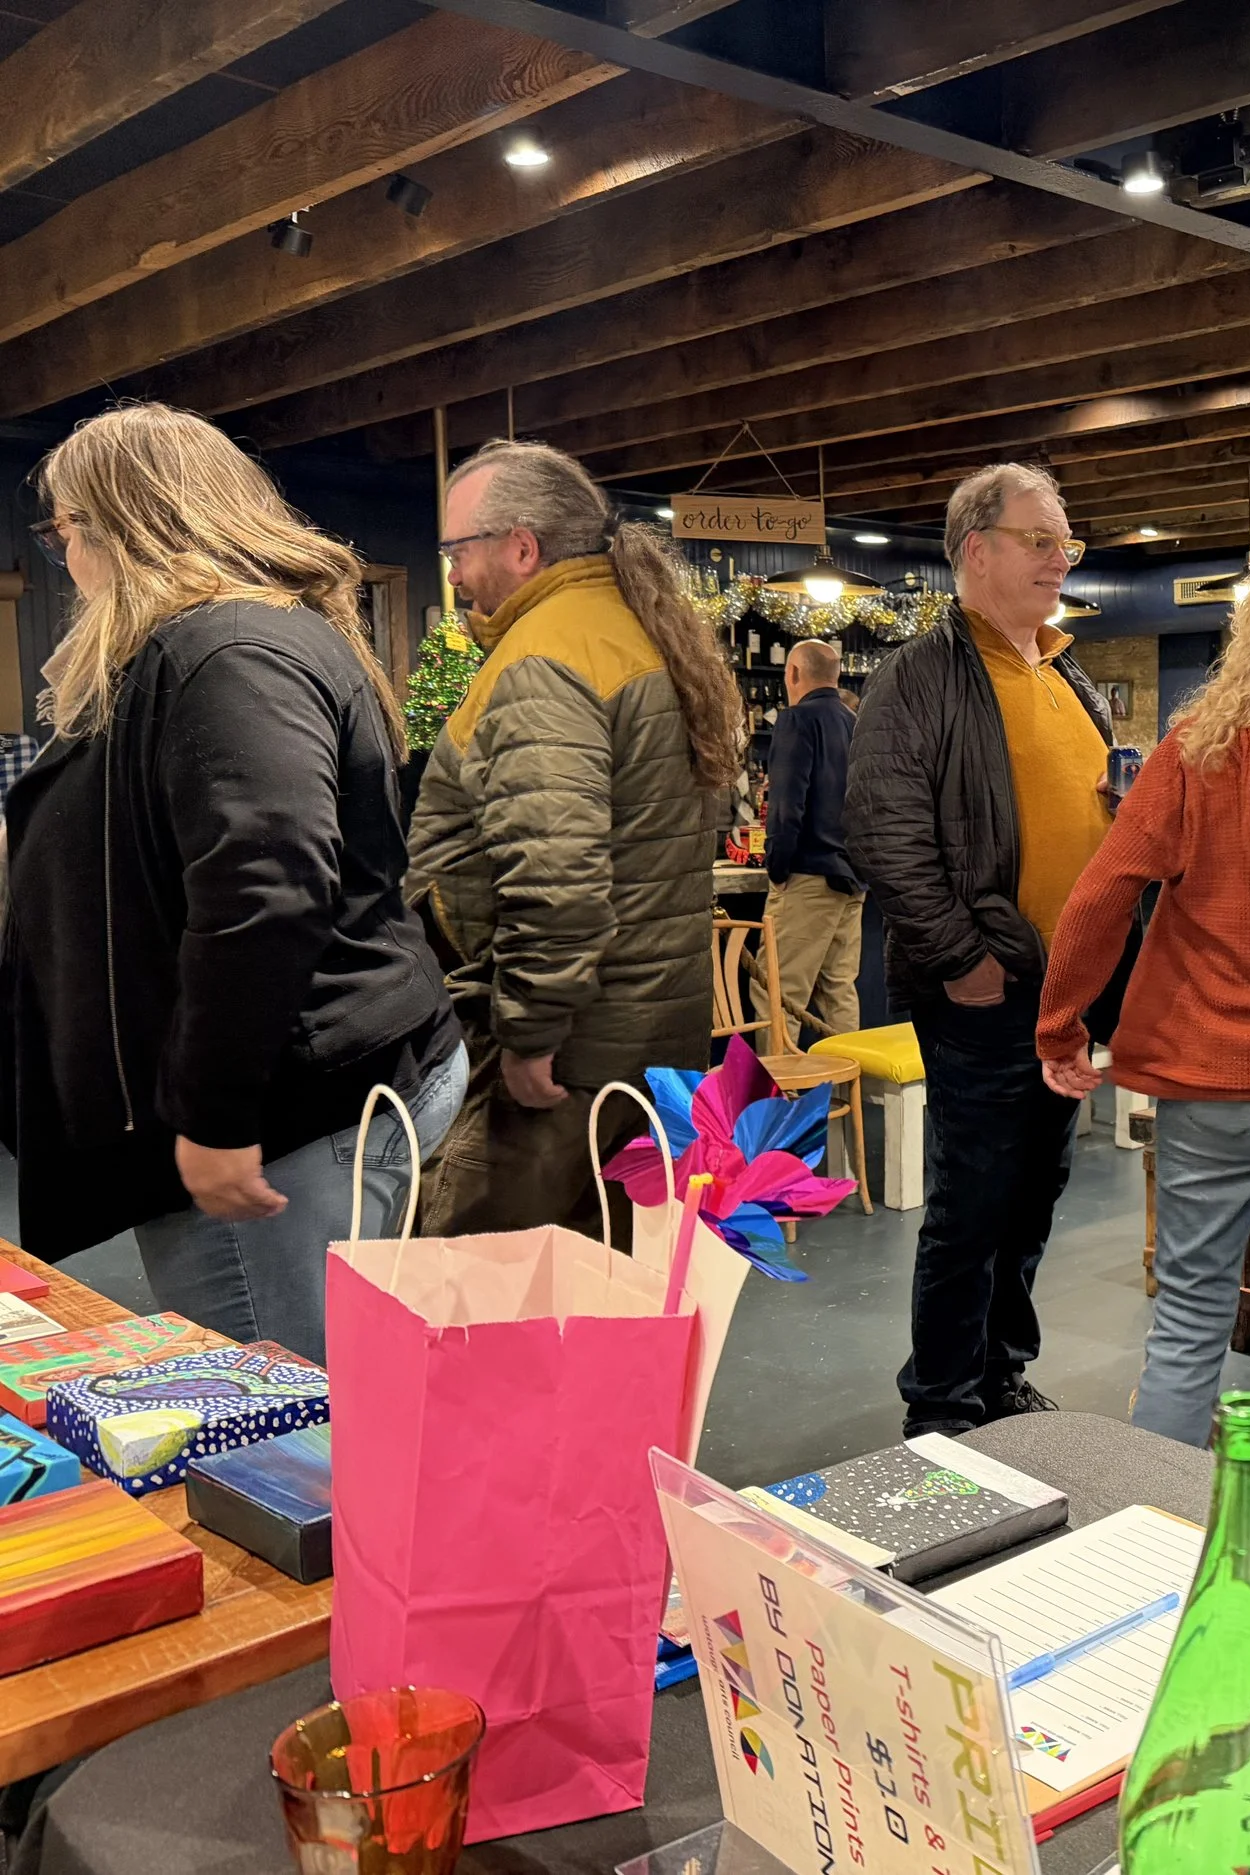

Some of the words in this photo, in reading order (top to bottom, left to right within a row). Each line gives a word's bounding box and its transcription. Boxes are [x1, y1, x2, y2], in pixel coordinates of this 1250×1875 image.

[682, 506, 746, 531] order
[751, 506, 812, 541] to-go
[719, 1679, 731, 1707] arts
[723, 1708, 741, 1761] council
[758, 1572, 789, 1640] BY
[775, 1647, 836, 1875] DONATION
[804, 1638, 841, 1753] paper
[832, 1756, 865, 1868] prints
[889, 1664, 932, 1809] T-shirts
[924, 1823, 947, 1852] &
